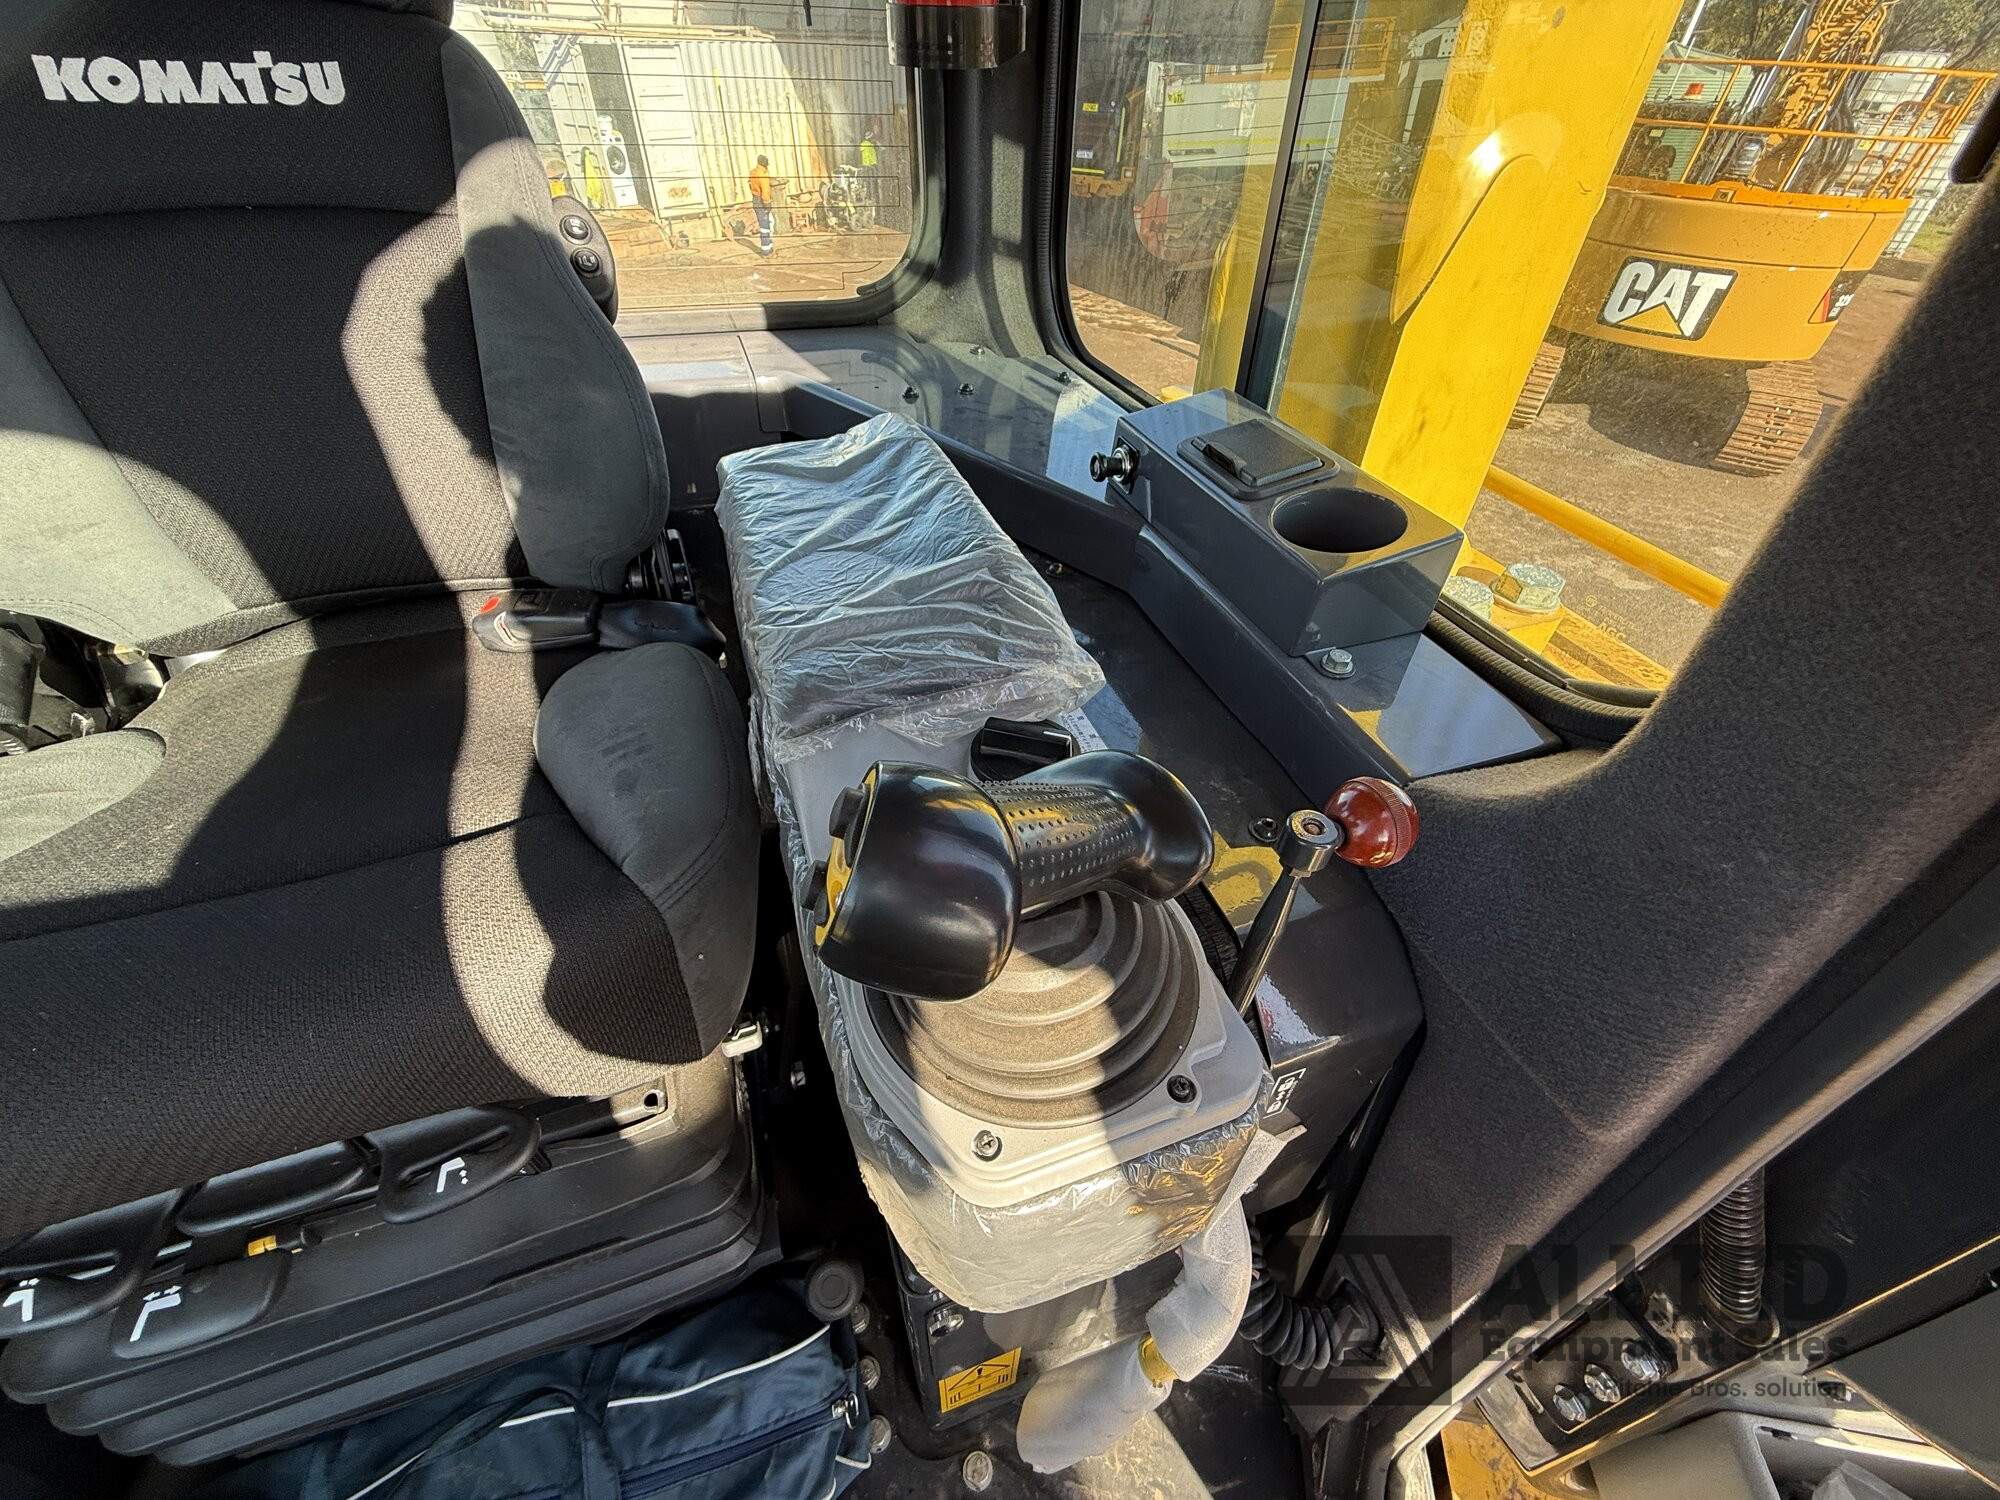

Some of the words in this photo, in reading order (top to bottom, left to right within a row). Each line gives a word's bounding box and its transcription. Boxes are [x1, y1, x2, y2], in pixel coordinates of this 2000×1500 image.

[31, 51, 345, 106] KOMATSU
[1603, 261, 1733, 337] CAT
[1598, 622, 1626, 644] AGC
